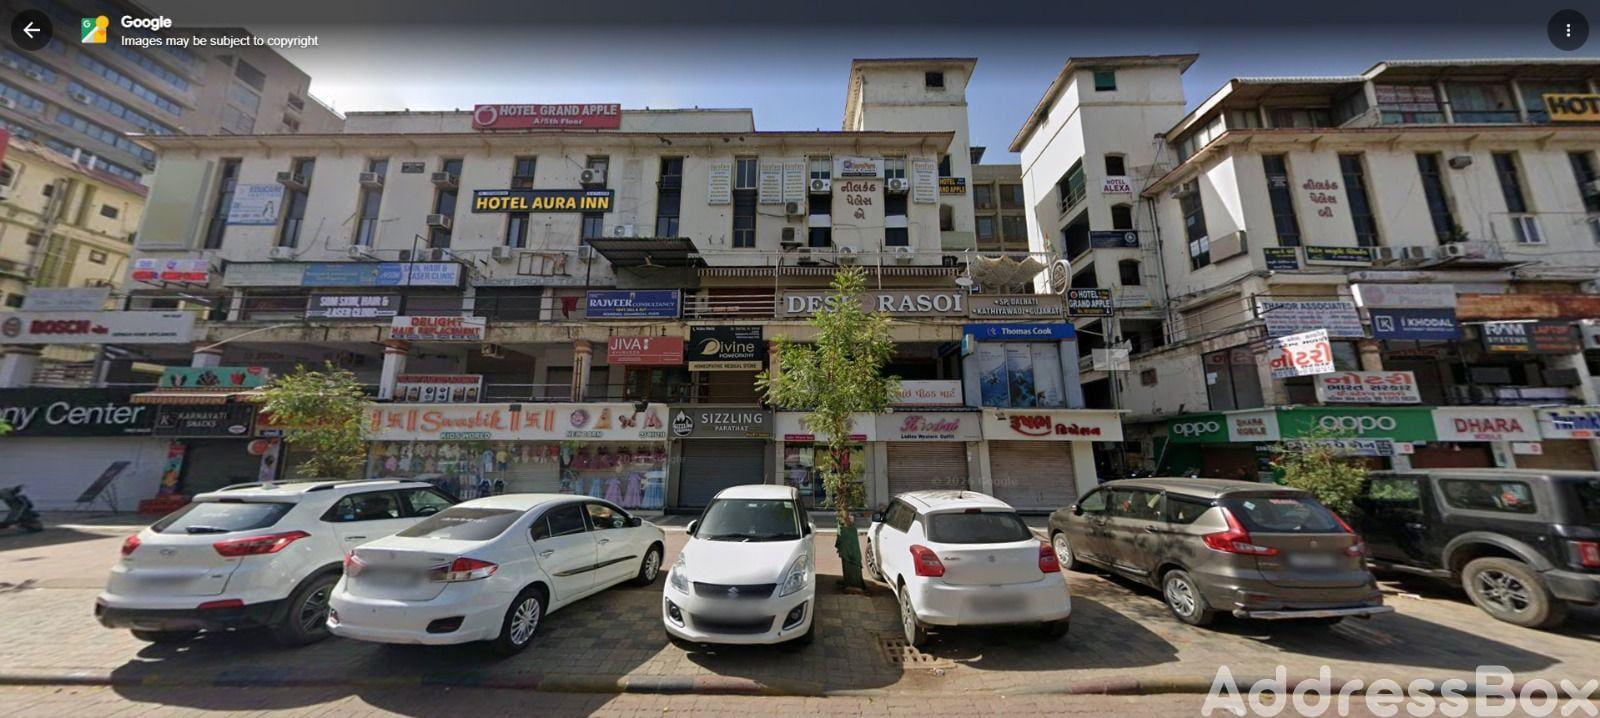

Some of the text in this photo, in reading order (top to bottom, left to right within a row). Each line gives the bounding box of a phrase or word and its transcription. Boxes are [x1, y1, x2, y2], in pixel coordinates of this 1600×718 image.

[500, 105, 617, 116] HOTEL GRAND APPLE
[841, 181, 876, 192] નીલકંઠ
[476, 197, 609, 209] HOTEL AURA INN
[847, 195, 873, 206] પેલેસ
[1079, 291, 1098, 299] HOTEL
[590, 298, 633, 307] RAJVEER
[878, 294, 962, 313] RASOI
[1069, 300, 1111, 308] GRAND APPLE
[327, 308, 351, 317] LASER
[411, 317, 464, 326] DELIGHT
[1407, 318, 1455, 327] KHODAL
[30, 320, 90, 335] BOSCH
[1002, 327, 1053, 335] Thomas Cook
[1485, 324, 1526, 335] RAM
[610, 338, 641, 350] JIVA
[1271, 342, 1332, 368] નોટરી
[1324, 373, 1413, 384] નોટરી
[0, 402, 145, 431] ny Center
[420, 409, 508, 433] Swastik
[702, 413, 762, 424] SIZZLING
[1236, 418, 1263, 426] DHARA
[1173, 421, 1220, 436] oppo
[1319, 416, 1396, 434] oppo
[1454, 418, 1523, 432] DHARA
[1237, 427, 1267, 435] MOBILE
